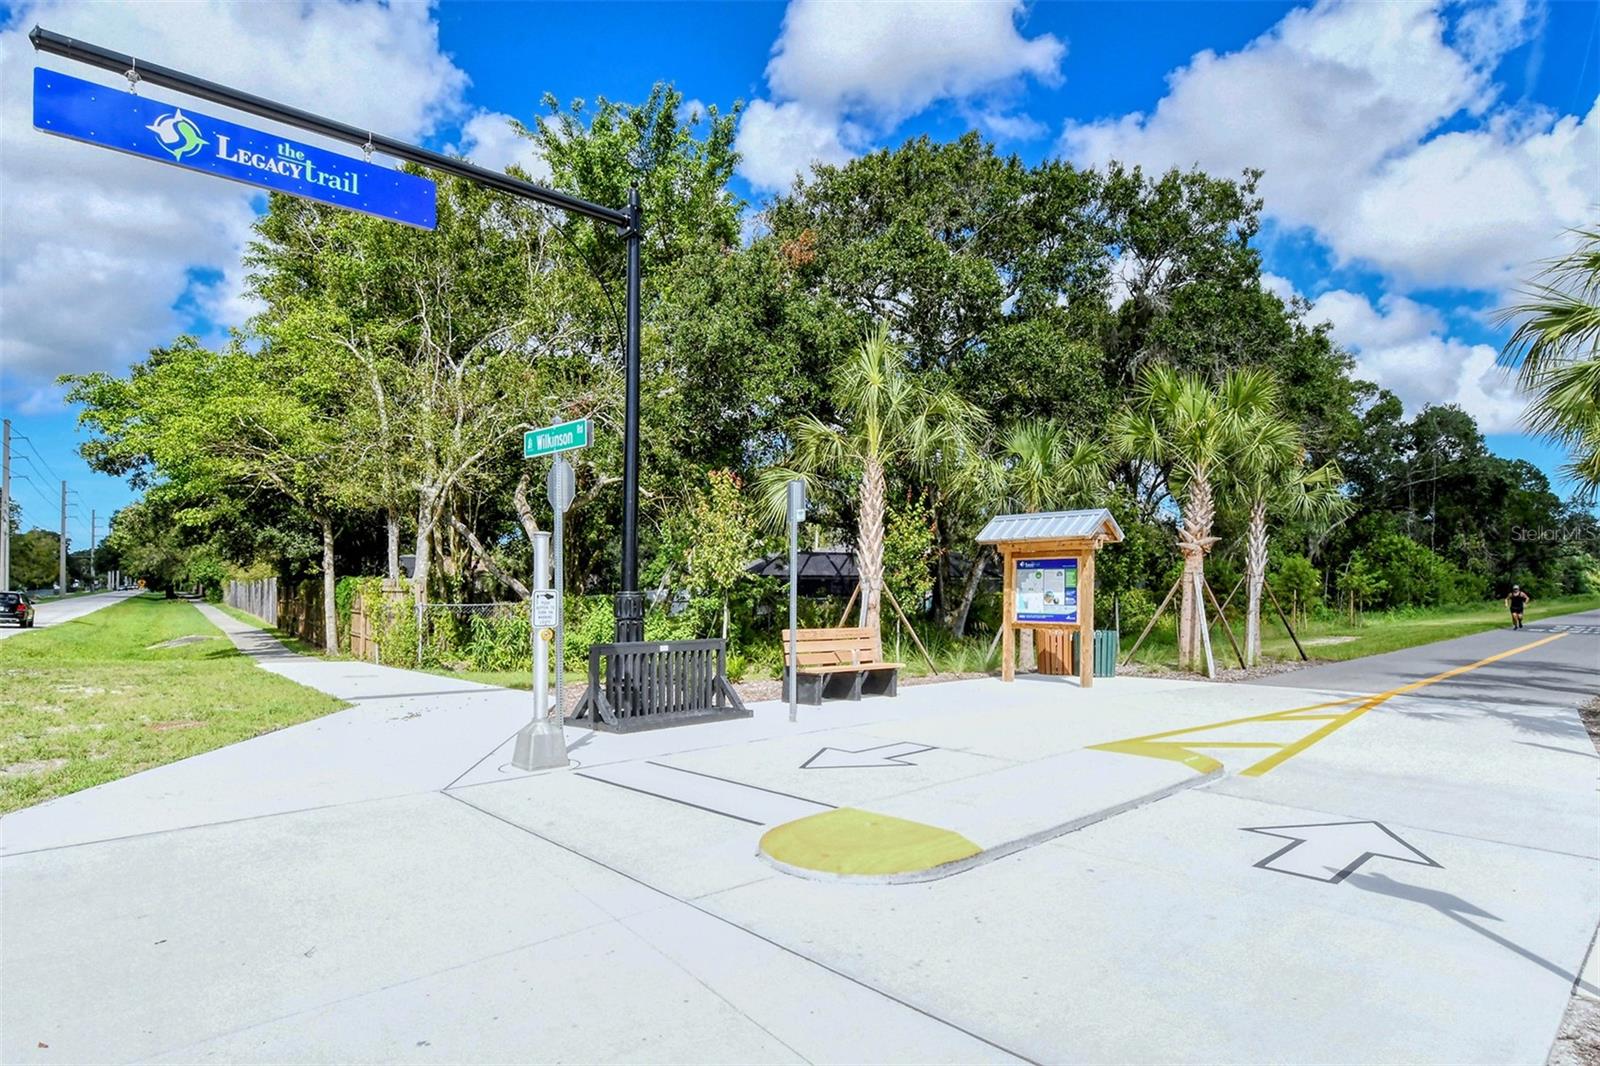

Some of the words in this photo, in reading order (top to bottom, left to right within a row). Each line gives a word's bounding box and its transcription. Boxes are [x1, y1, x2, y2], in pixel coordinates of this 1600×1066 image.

[216, 134, 304, 180] LEGACY
[305, 160, 360, 195] trail
[277, 142, 305, 161] the
[536, 432, 573, 451] Wilkinson
[576, 423, 584, 434] Rd
